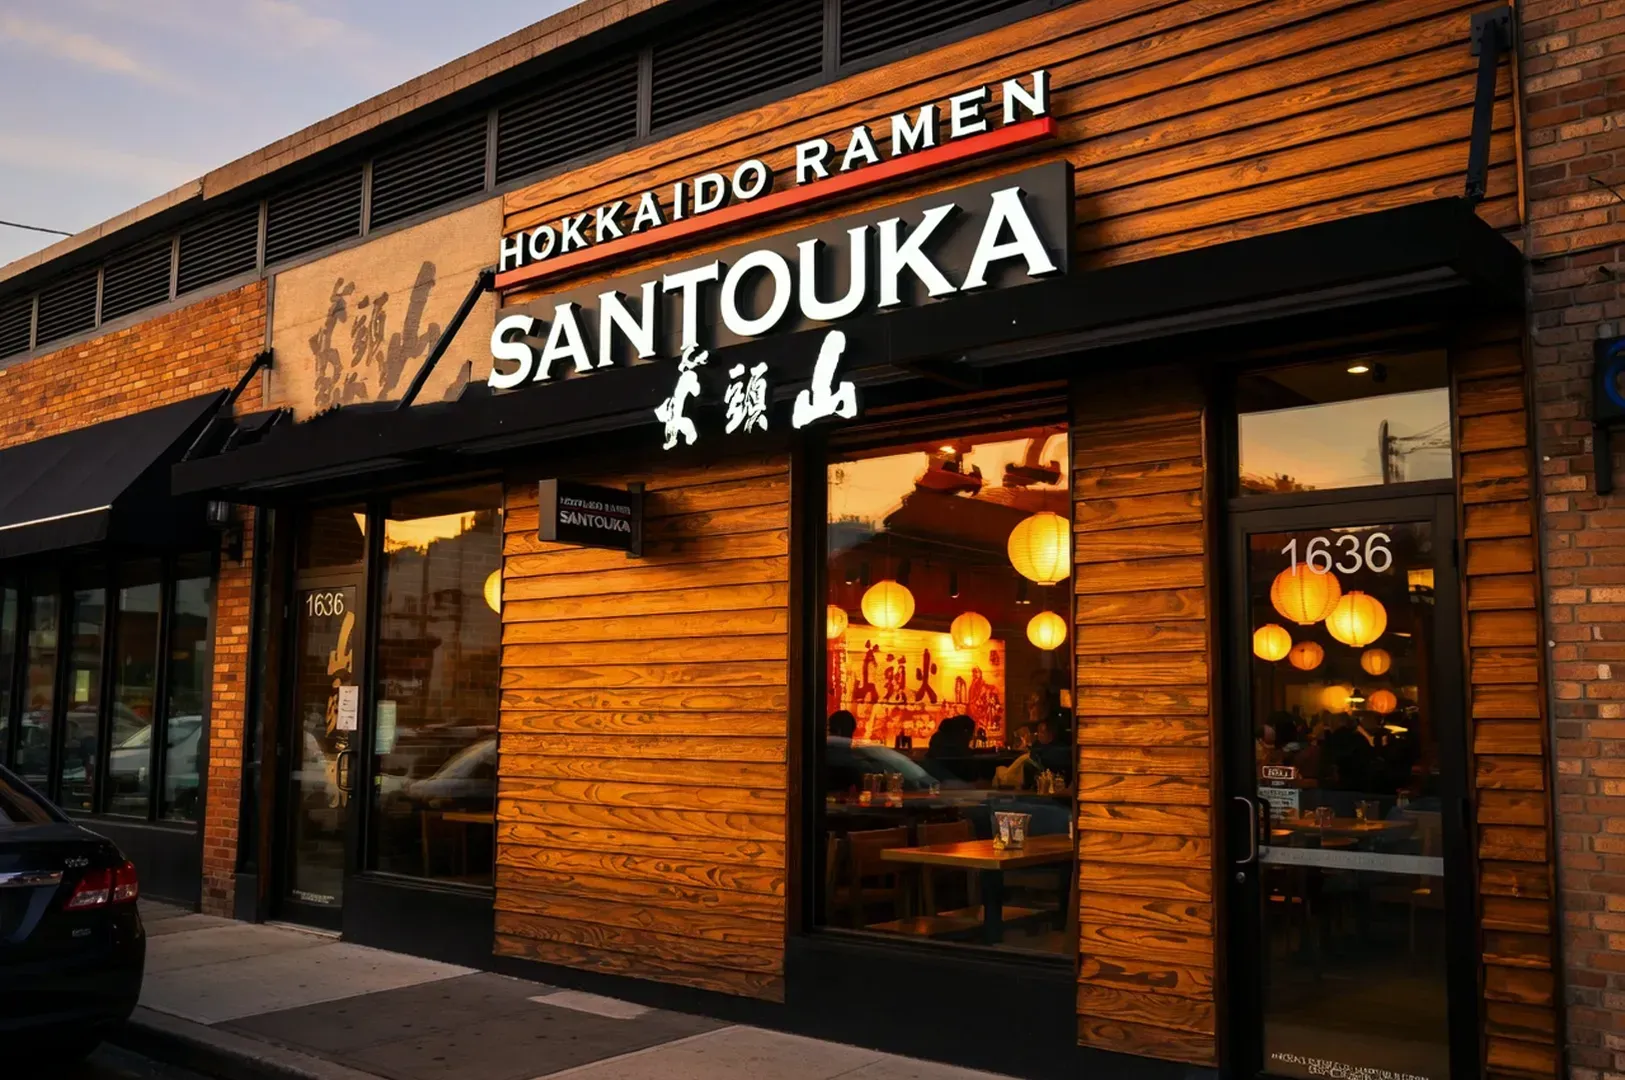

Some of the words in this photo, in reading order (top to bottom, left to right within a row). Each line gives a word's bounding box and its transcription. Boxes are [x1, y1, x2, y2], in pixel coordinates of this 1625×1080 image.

[499, 159, 768, 272] HOKKAIDO
[795, 69, 1046, 184] RAMEN
[487, 186, 1057, 390] SANTOUKA
[560, 510, 631, 533] SANTOUKA
[1281, 532, 1393, 577] 1636
[306, 592, 344, 617] 1636
